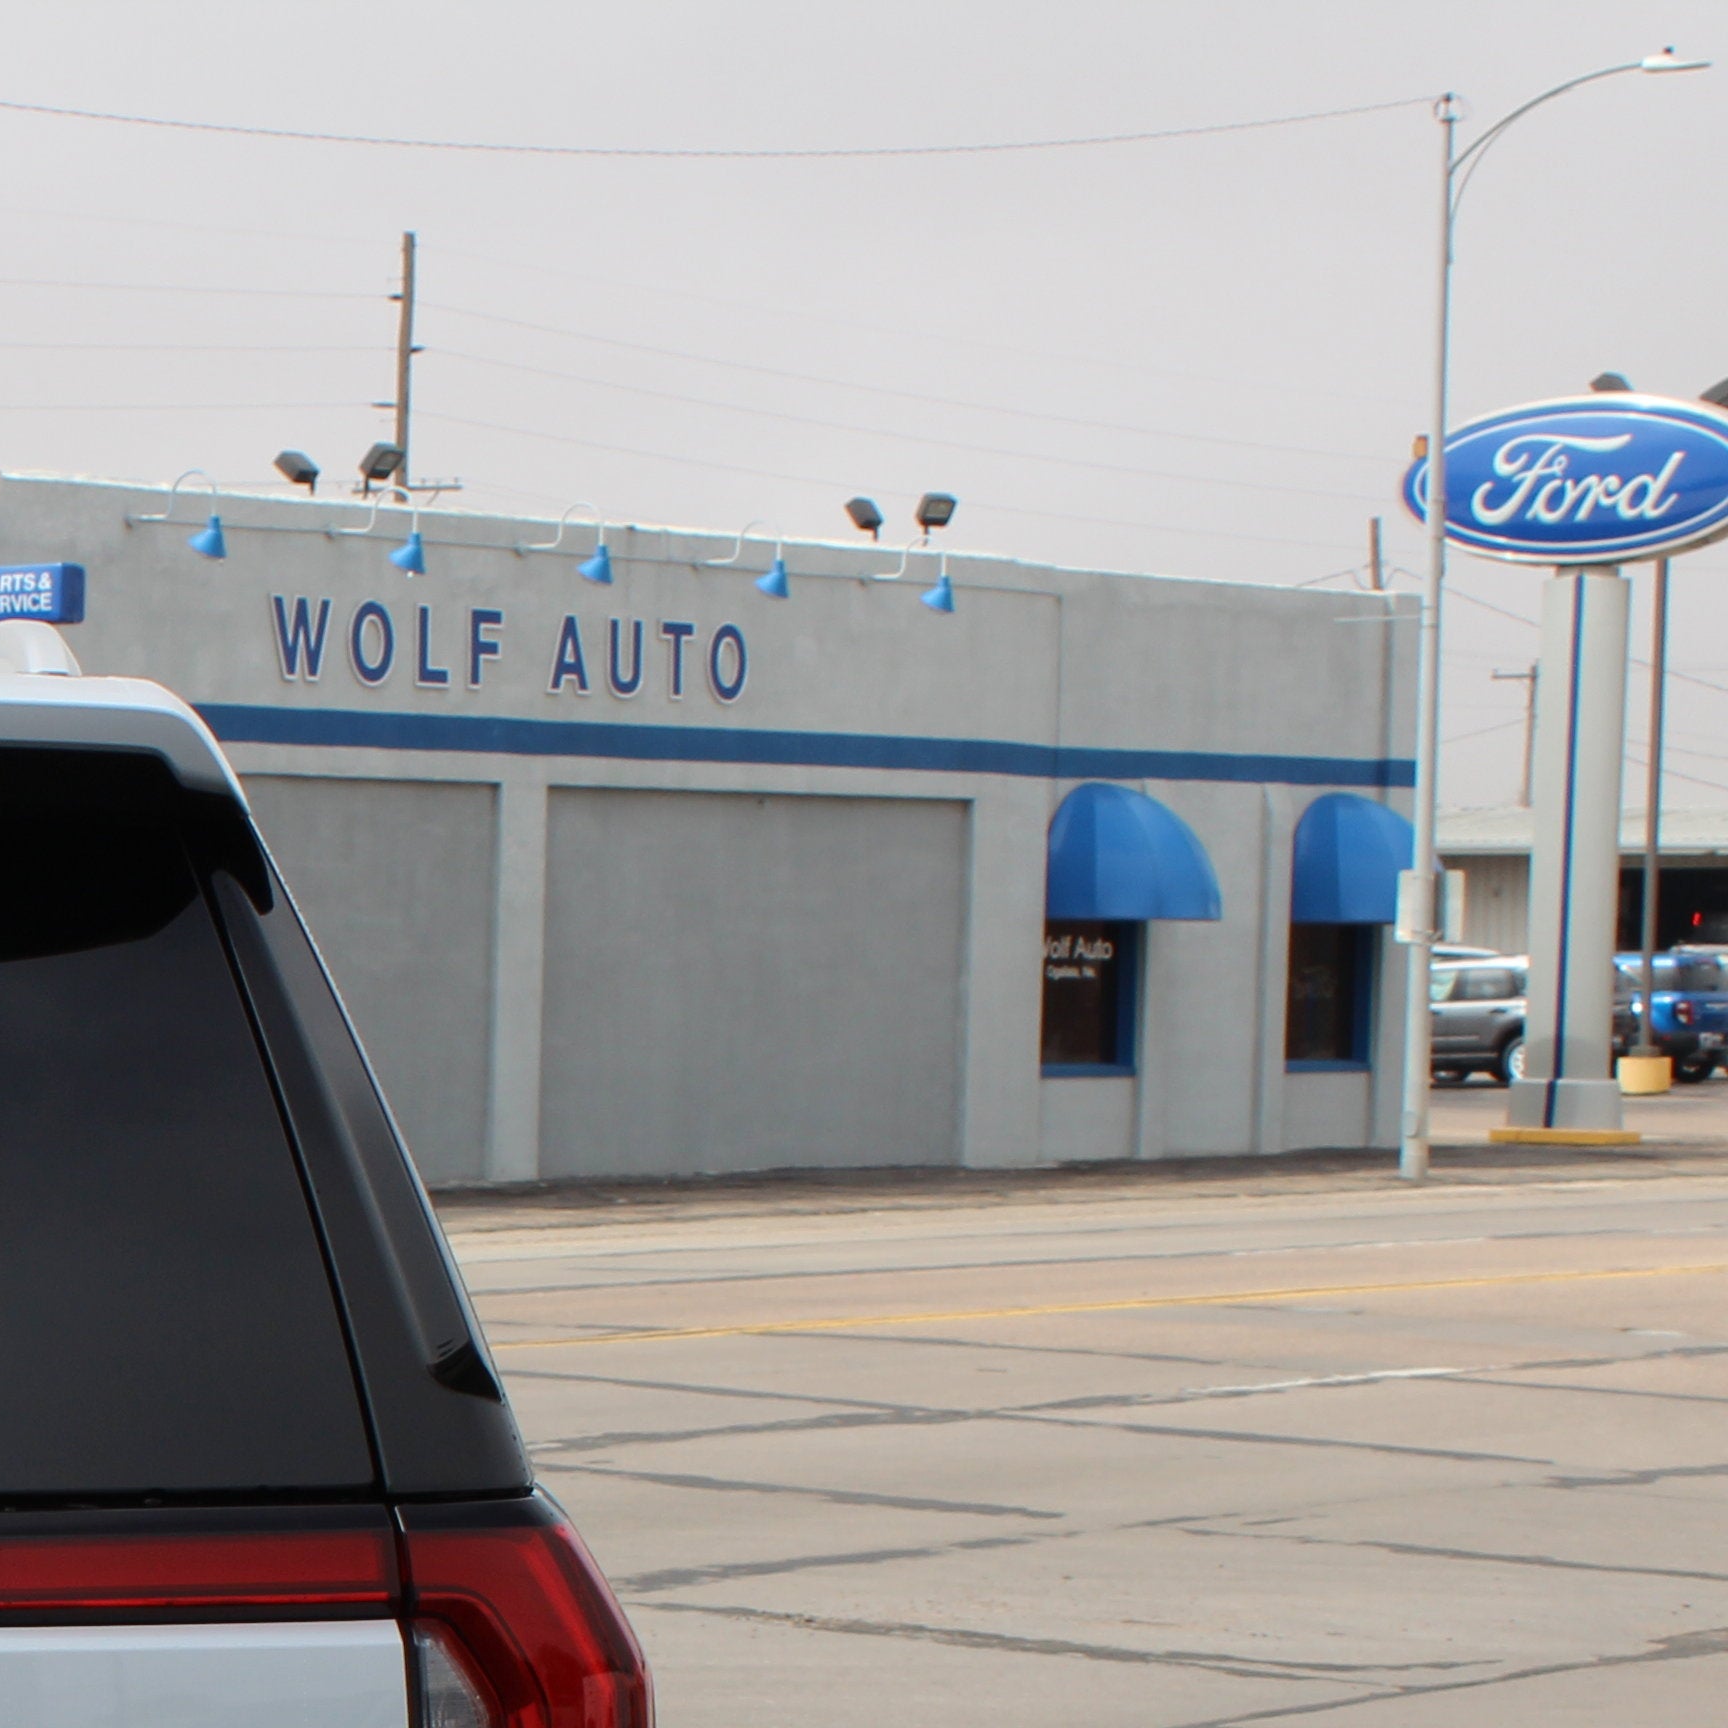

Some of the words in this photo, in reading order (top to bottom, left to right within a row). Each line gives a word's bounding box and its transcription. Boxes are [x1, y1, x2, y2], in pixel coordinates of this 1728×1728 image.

[1471, 433, 1686, 526] Ford
[38, 572, 51, 590] &
[271, 594, 505, 689] WOLF
[546, 613, 748, 705] AUTO
